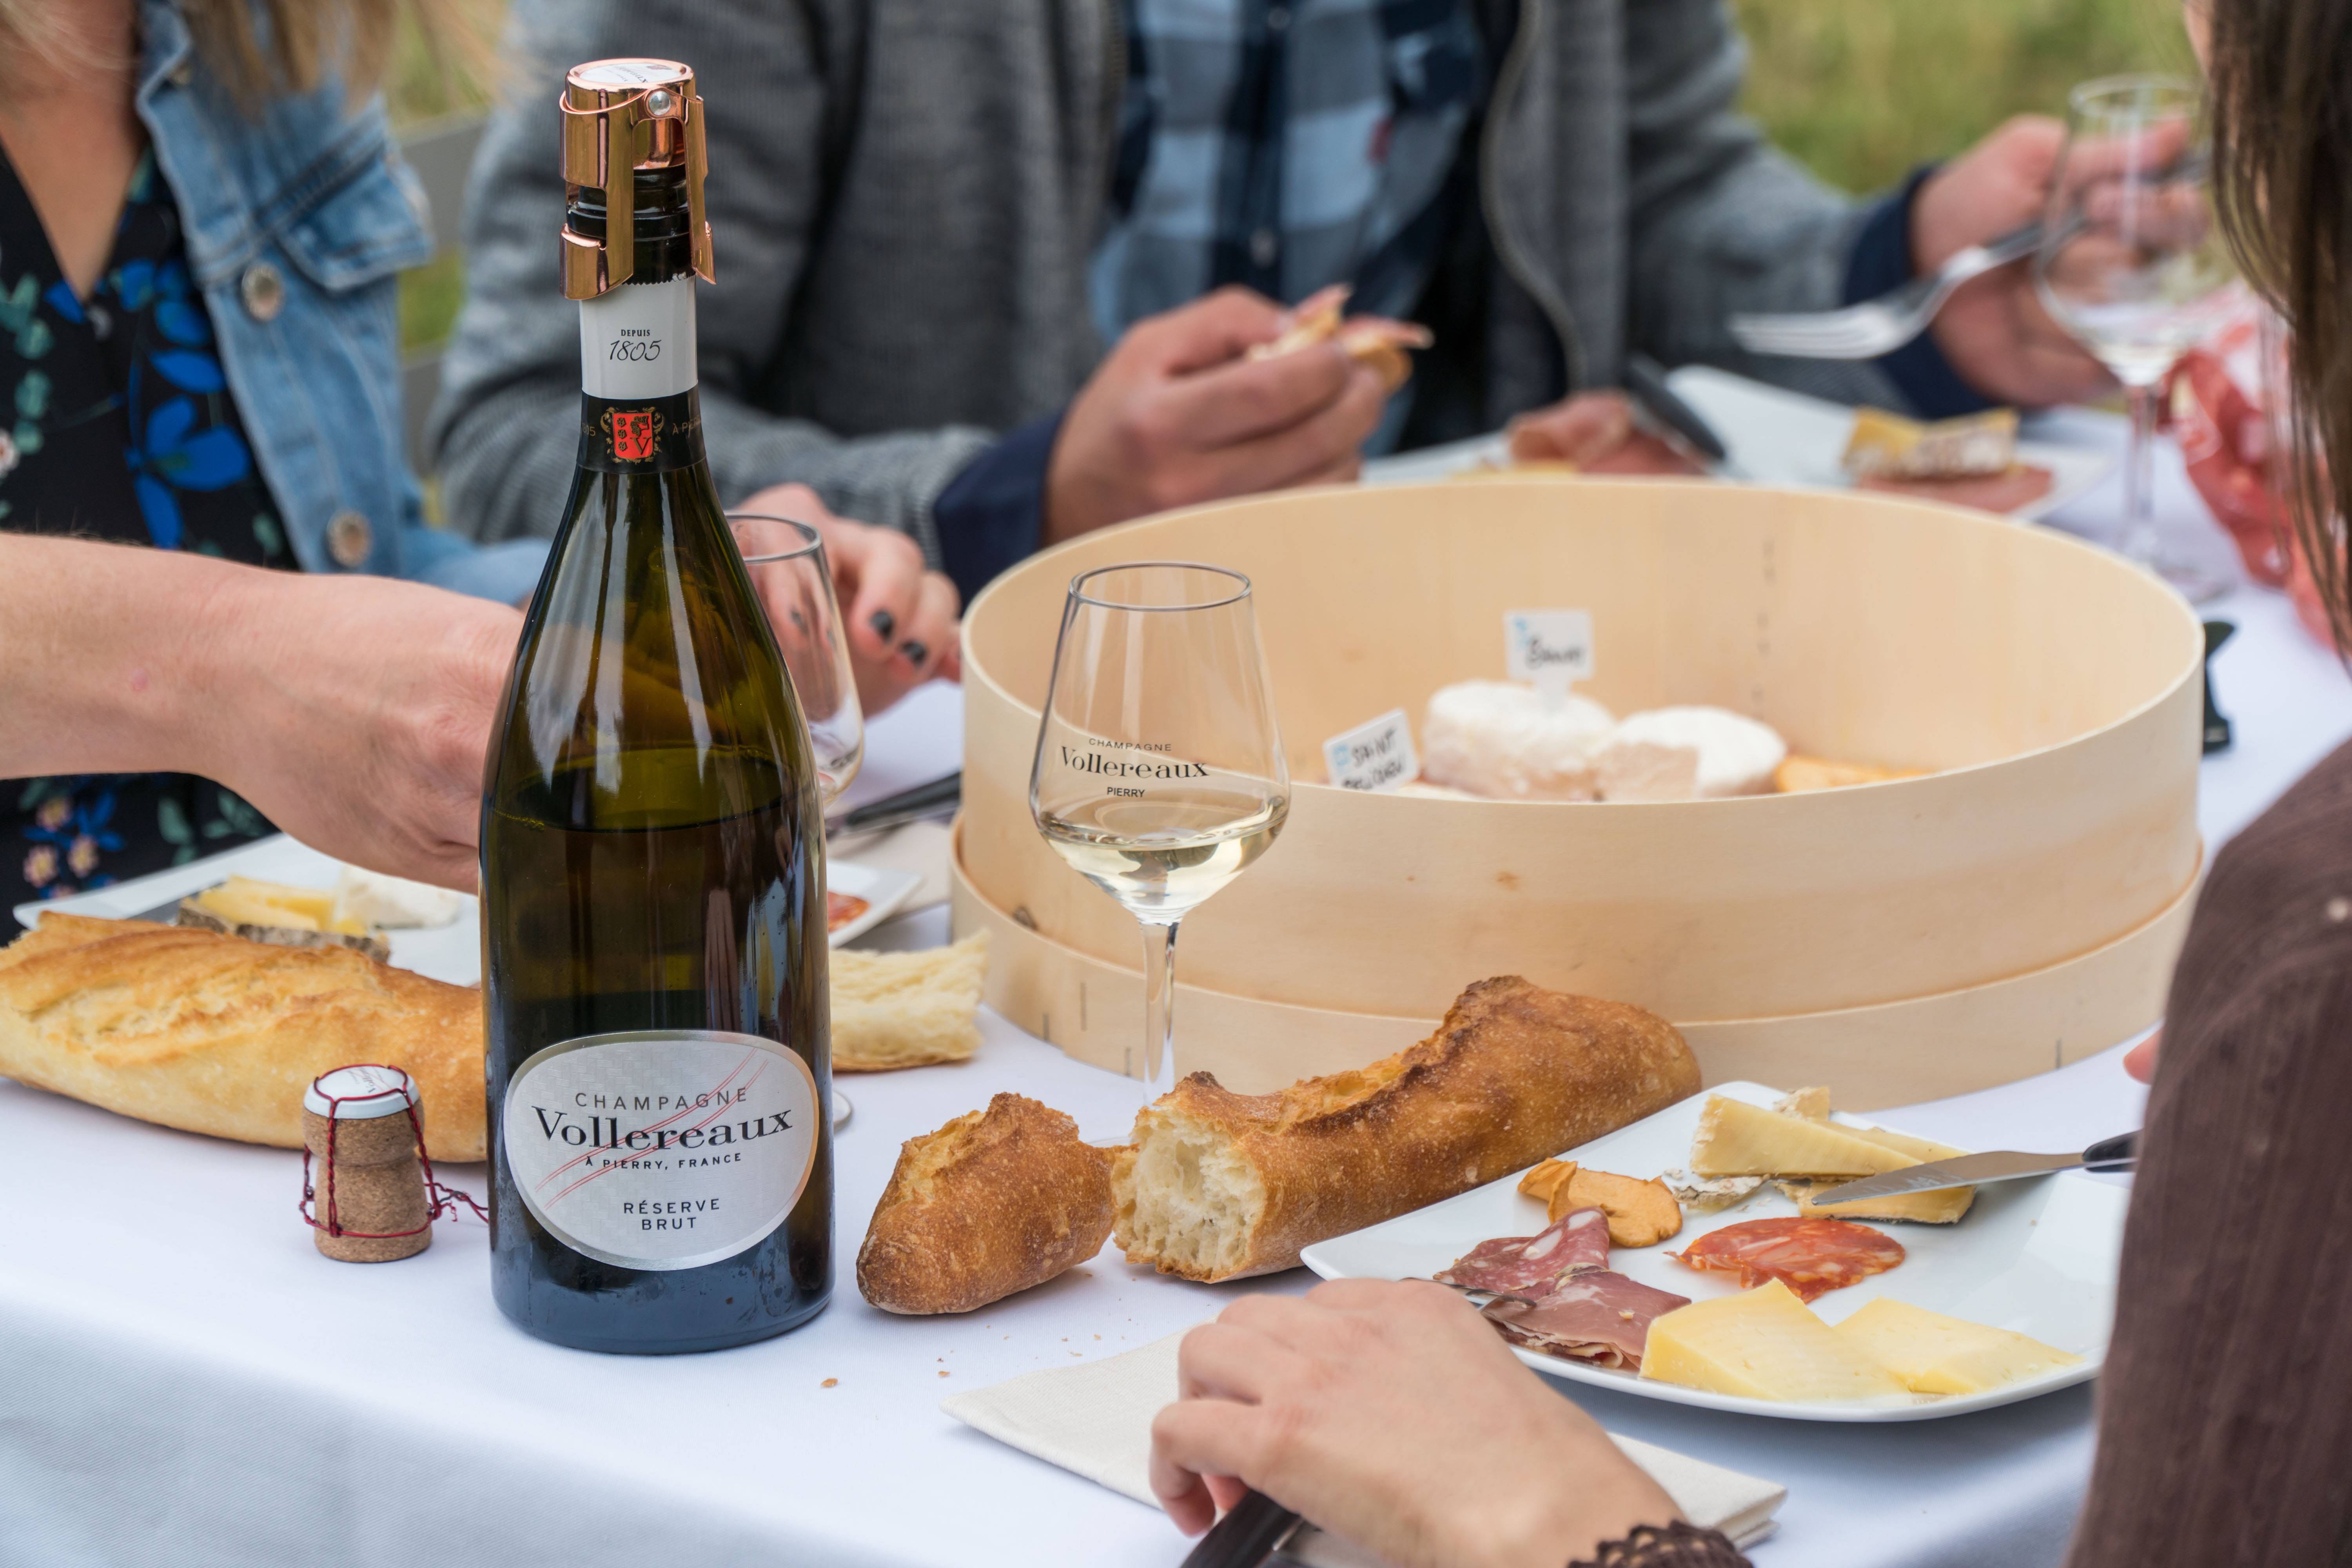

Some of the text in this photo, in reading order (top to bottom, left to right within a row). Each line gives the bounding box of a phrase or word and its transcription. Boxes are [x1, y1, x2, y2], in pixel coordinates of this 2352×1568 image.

[610, 339, 662, 361] 1805
[1089, 738, 1172, 751] CHAMPAGNE
[1061, 746, 1210, 779] Vollereaux
[1107, 786, 1145, 798] PIERRY
[575, 1087, 746, 1111] CHAMPAGNE
[531, 1106, 793, 1151] Vollereaux
[585, 1152, 741, 1171] À PIERRY, FRANCE
[624, 1198, 720, 1214] RÉSERVE
[642, 1217, 697, 1230] BRUT
